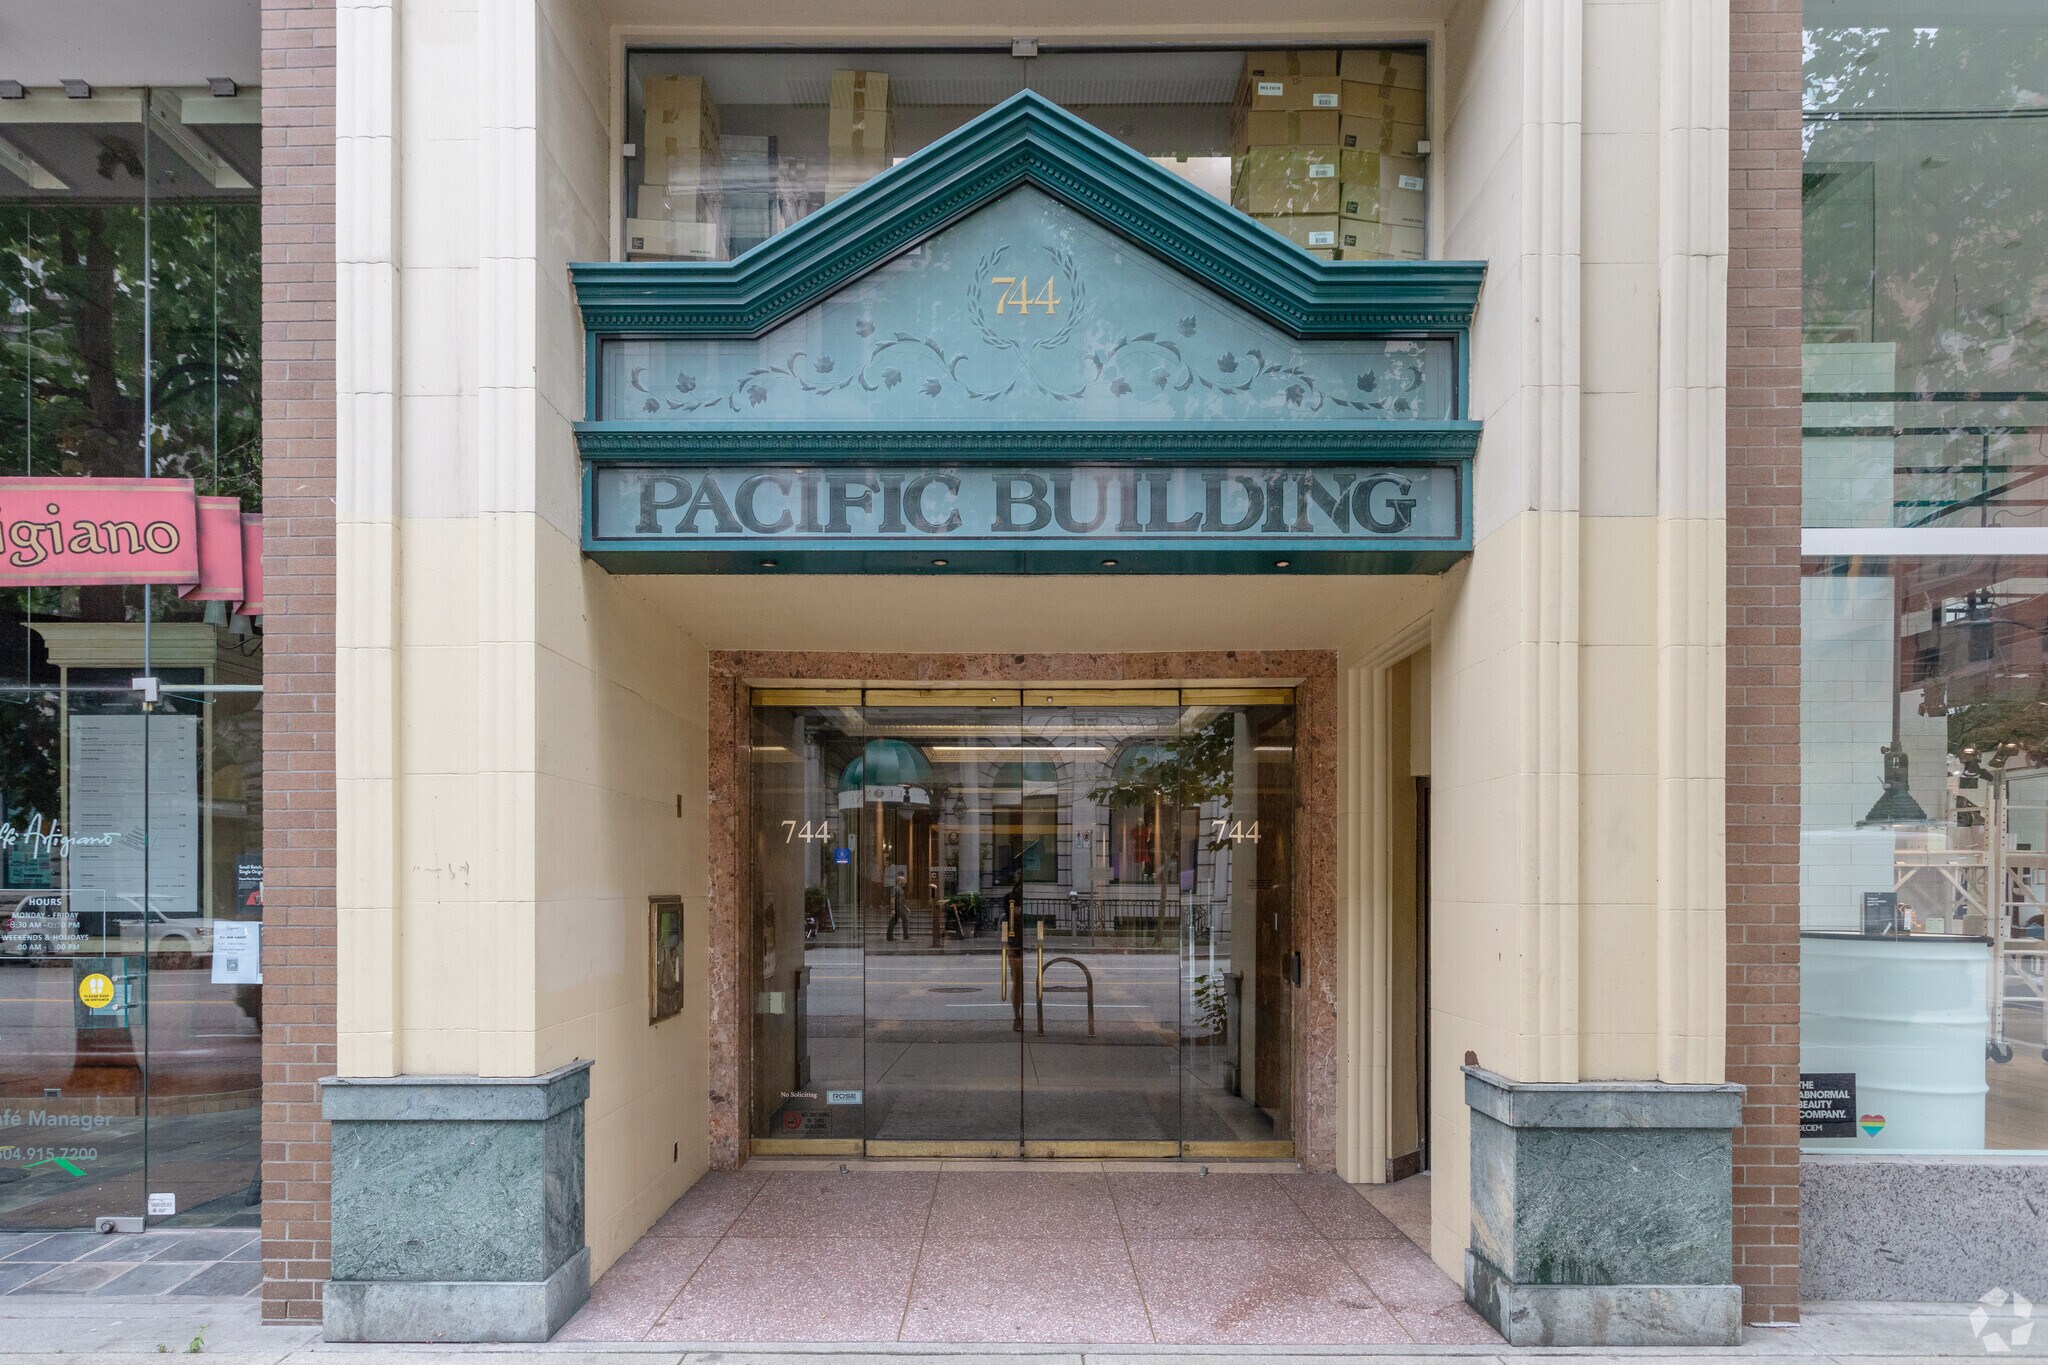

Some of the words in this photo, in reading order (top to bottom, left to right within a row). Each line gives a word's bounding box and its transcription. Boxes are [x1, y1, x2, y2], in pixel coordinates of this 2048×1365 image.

[991, 274, 1063, 316] 744
[634, 472, 963, 535] PACIFIC
[990, 471, 1417, 534] BUILDING
[0, 502, 181, 568] giano
[23, 812, 122, 860] Artigiano
[780, 820, 832, 844] 744
[1211, 820, 1262, 844] 744
[28, 898, 62, 906] HOURS
[12, 911, 45, 919] MONDAY
[52, 911, 79, 919] FRIDAY
[29, 943, 42, 951] AM
[67, 943, 81, 951] PM
[790, 1091, 818, 1099] Soliciting
[1799, 1090, 1850, 1099] ABNORMAL
[1798, 1100, 1832, 1109] BEAUTY
[0, 1108, 22, 1126] fé
[28, 1109, 113, 1131] Manager
[1799, 1109, 1847, 1119] COMPANY.
[0, 1147, 98, 1161] 04.9157200
